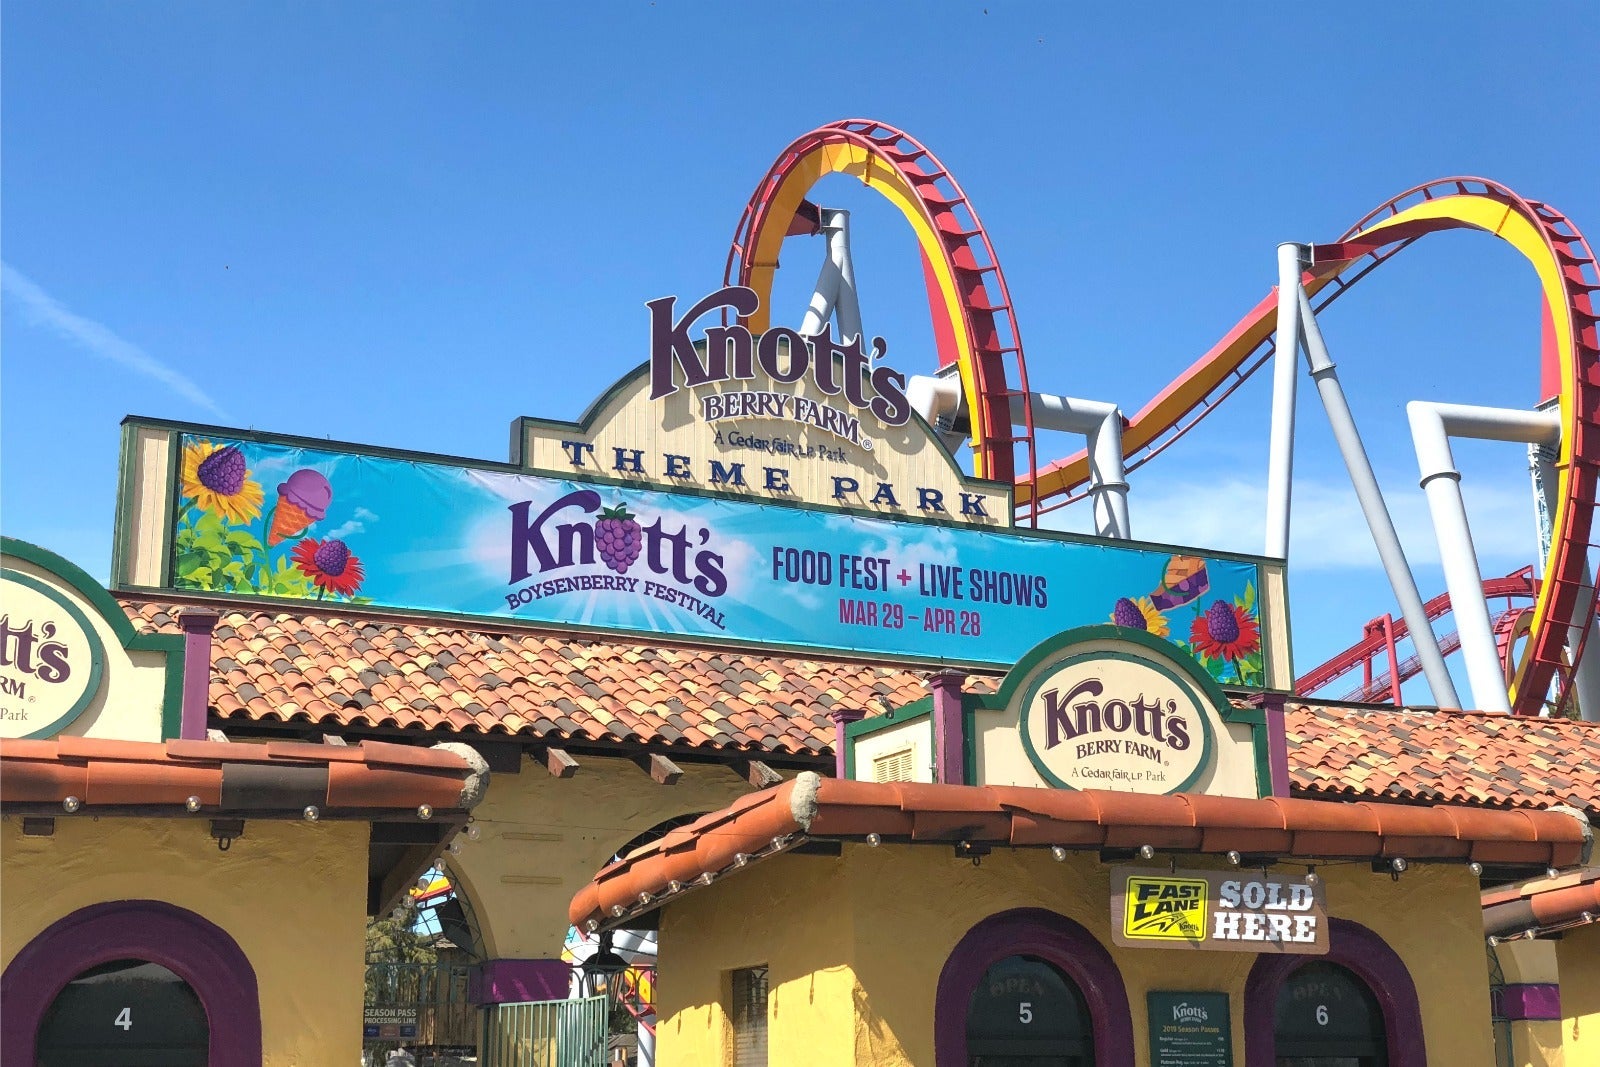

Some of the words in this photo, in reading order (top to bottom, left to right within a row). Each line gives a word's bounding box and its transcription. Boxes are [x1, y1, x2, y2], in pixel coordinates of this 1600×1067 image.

[645, 286, 911, 426] Knott's
[702, 391, 790, 422] BERRY
[793, 396, 860, 445] FARM
[714, 430, 724, 445] A
[818, 445, 847, 463] Park
[562, 441, 789, 491] THEME
[831, 476, 989, 516] PARK
[508, 490, 727, 597] Kntt's
[773, 546, 832, 585] FOOD
[840, 554, 890, 592] FEST
[897, 569, 911, 586] +
[920, 563, 963, 600] LIVE
[970, 568, 1047, 608] SHOWS
[505, 575, 639, 610] BOYSENBERRY
[644, 580, 726, 630] FESTIVAL
[840, 598, 877, 626] MAR
[883, 603, 903, 629] 29
[924, 607, 955, 633] APR
[961, 610, 980, 636] 28
[0, 707, 28, 721] Park
[1041, 678, 1190, 751] Knott's
[1076, 739, 1121, 759] BERRY
[1125, 740, 1161, 764] FARM
[1072, 767, 1079, 777] A
[1146, 771, 1166, 781] Park
[1136, 883, 1201, 900] FAST
[1219, 880, 1314, 911] SOLD
[1134, 898, 1199, 922] LANE
[1212, 911, 1316, 942] HERE
[115, 1008, 132, 1030] 4
[1020, 1003, 1032, 1023] 5
[1173, 1003, 1208, 1020] Knott's
[1316, 1005, 1328, 1025] 6
